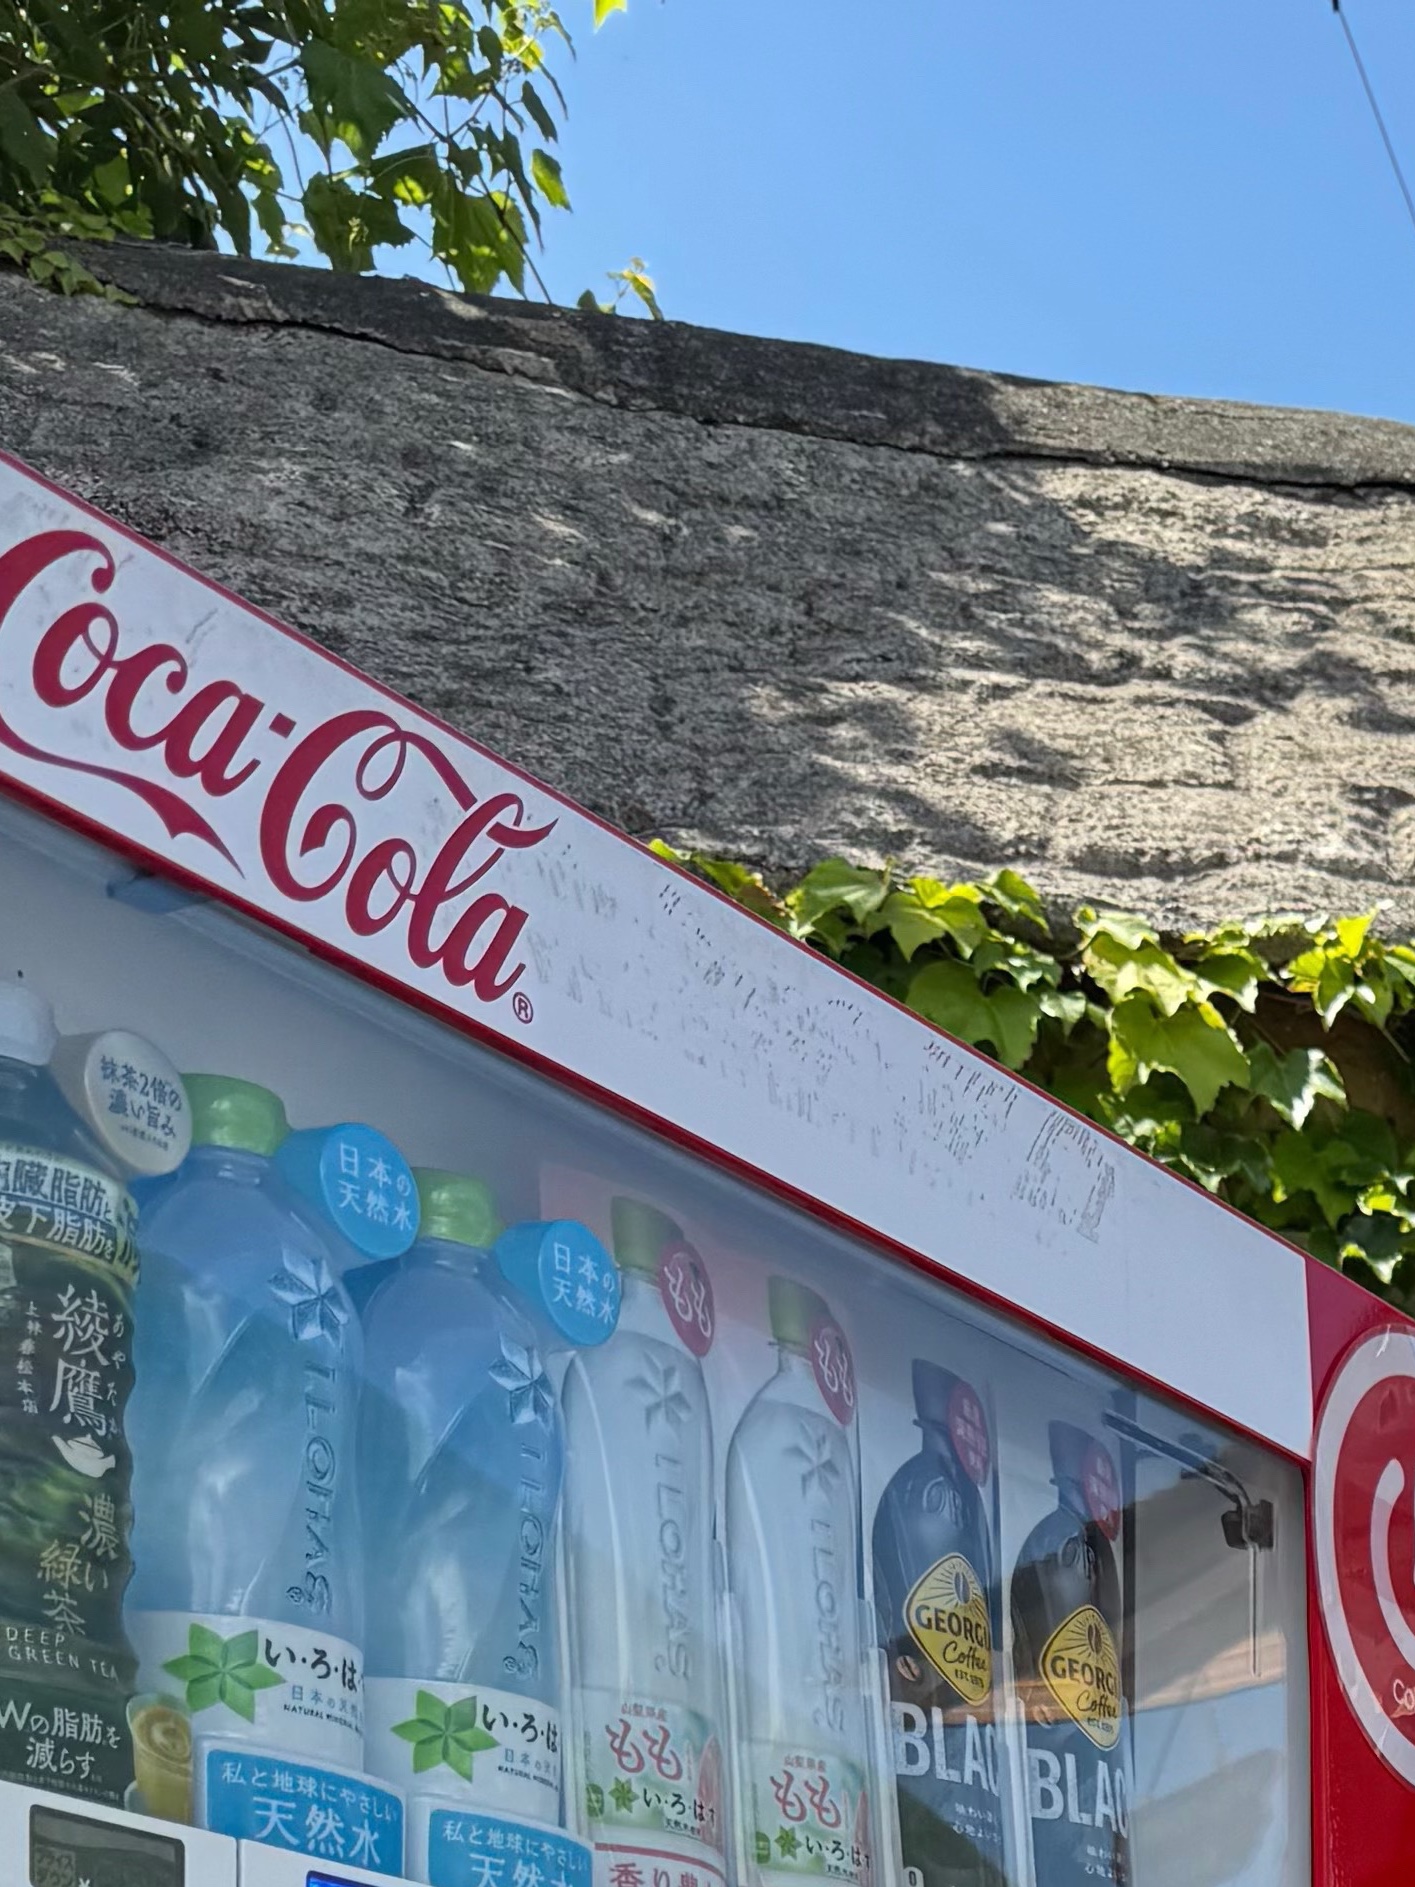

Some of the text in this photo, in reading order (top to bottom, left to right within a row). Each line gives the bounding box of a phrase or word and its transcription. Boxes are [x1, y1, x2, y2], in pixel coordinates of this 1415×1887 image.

[0, 529, 560, 1003] Coca-Cola
[336, 1145, 413, 1199] 日本の
[52, 1283, 109, 1437] 綾鷹
[37, 1539, 87, 1636] 緑茶
[5, 1626, 67, 1648] DEEP
[8, 1647, 80, 1670] GREEN
[26, 1736, 95, 1780] 減らす
[605, 1717, 684, 1782] もも
[222, 1761, 398, 1820] 私と地球にやさしい
[770, 1769, 842, 1829] もも
[254, 1795, 381, 1867] 天然水
[442, 1819, 589, 1873] 私と地球にやさしい
